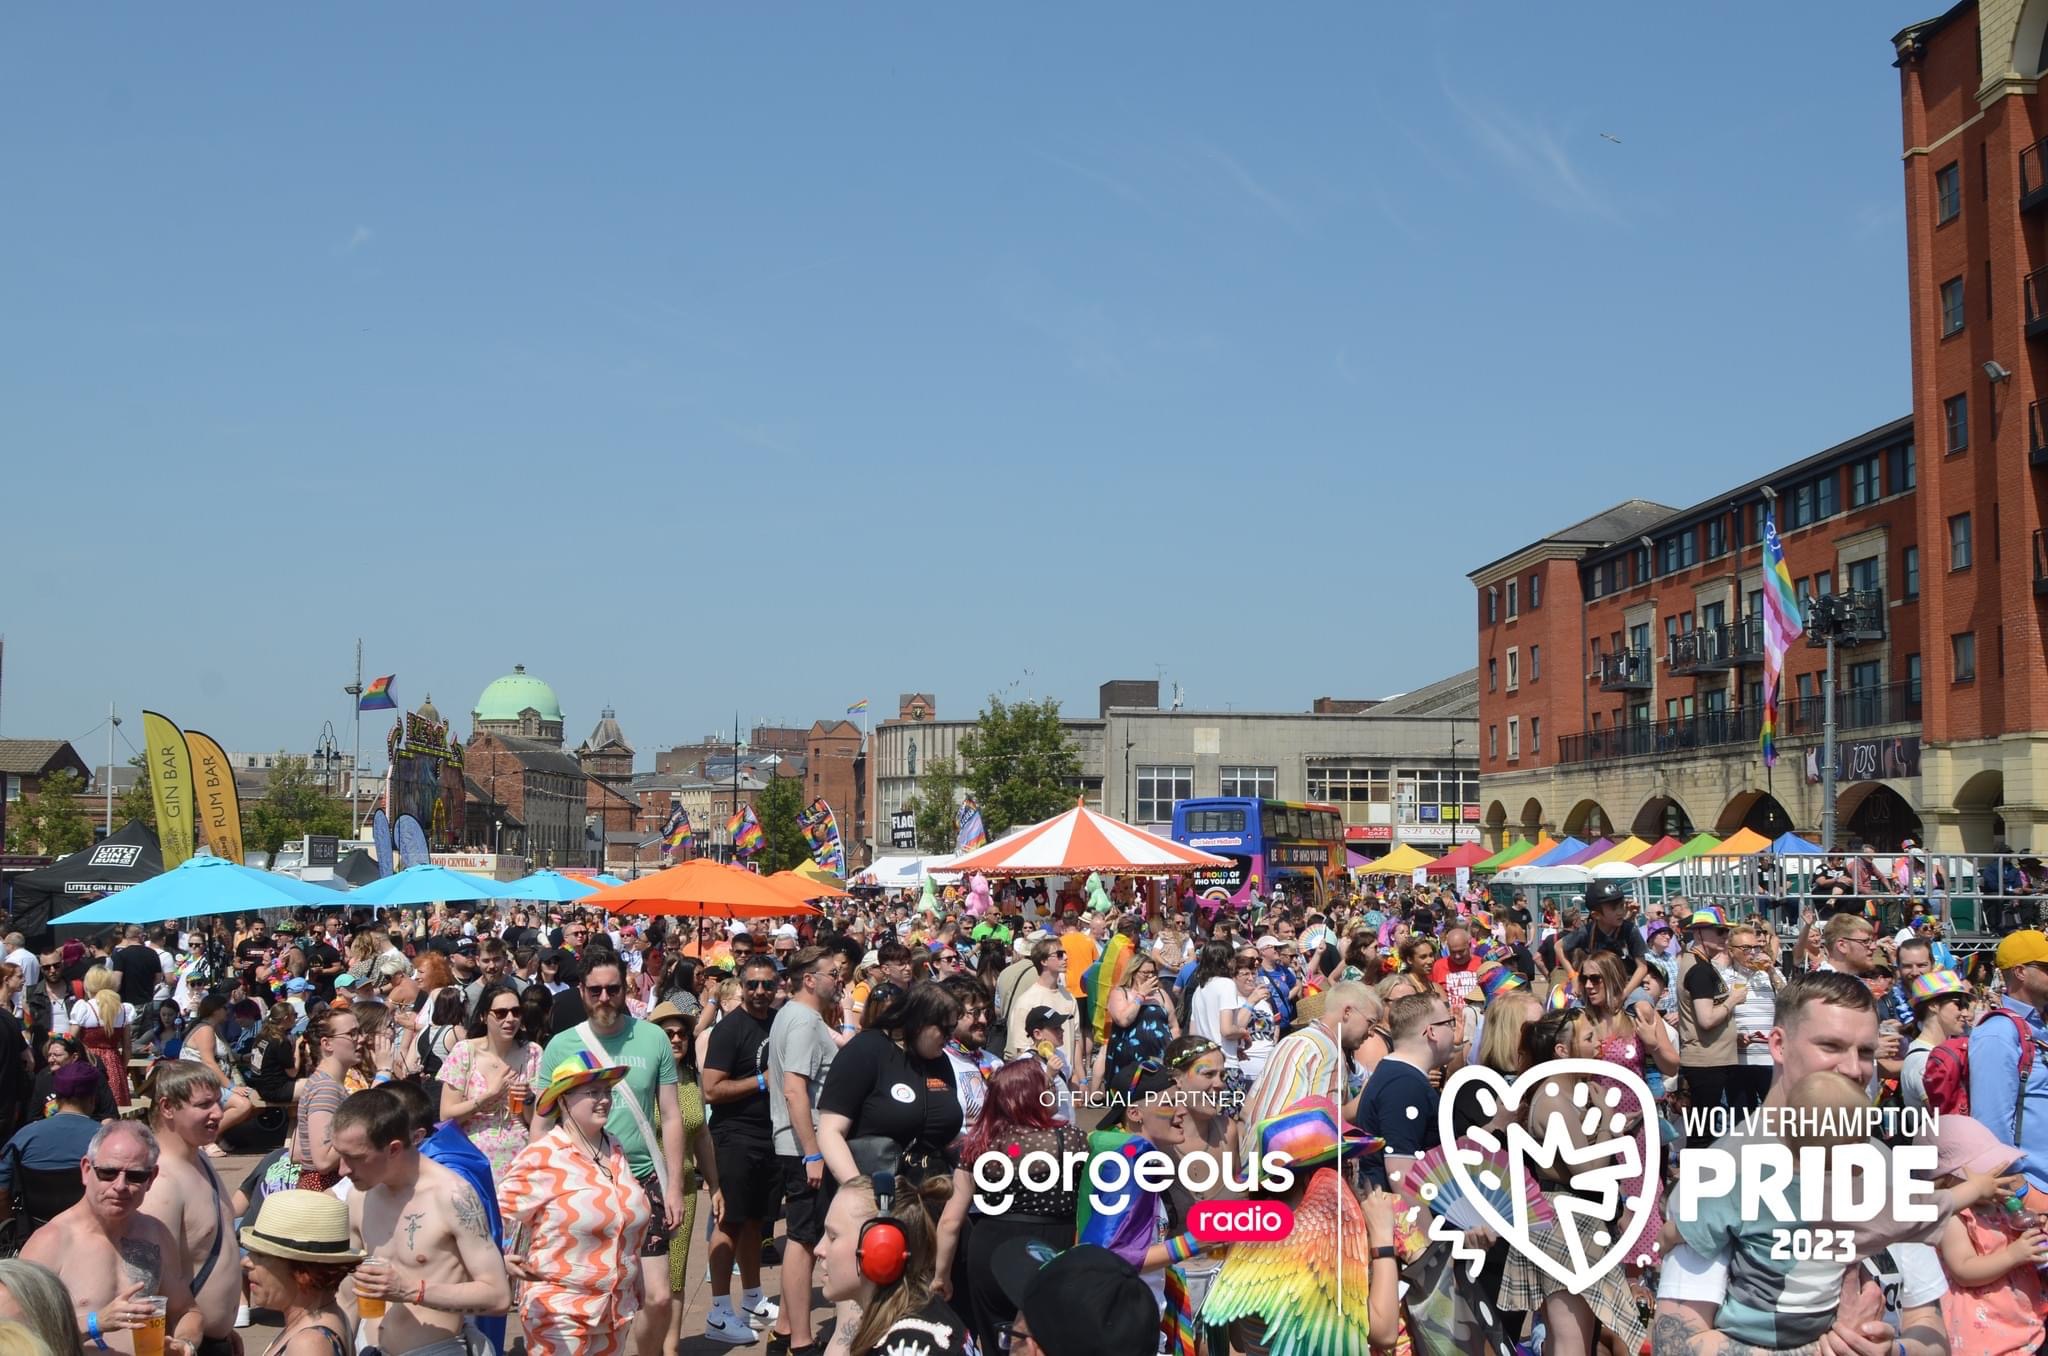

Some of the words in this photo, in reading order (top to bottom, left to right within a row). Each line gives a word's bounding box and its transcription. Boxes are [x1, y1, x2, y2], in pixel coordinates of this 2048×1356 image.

[162, 745, 178, 780] BAR
[203, 755, 220, 788] BAR
[165, 786, 180, 818] GIN
[209, 792, 226, 828] RUM
[892, 814, 914, 830] FLAG
[431, 857, 447, 868] OOD
[447, 857, 477, 868] CENTRAL
[1293, 848, 1299, 862] OF
[1299, 849, 1310, 862] WHO
[1310, 849, 1319, 862] YOU
[1319, 849, 1328, 862] ARE
[1202, 871, 1229, 879] PROUD
[1229, 871, 1241, 879] OF
[1210, 878, 1226, 886] YOU
